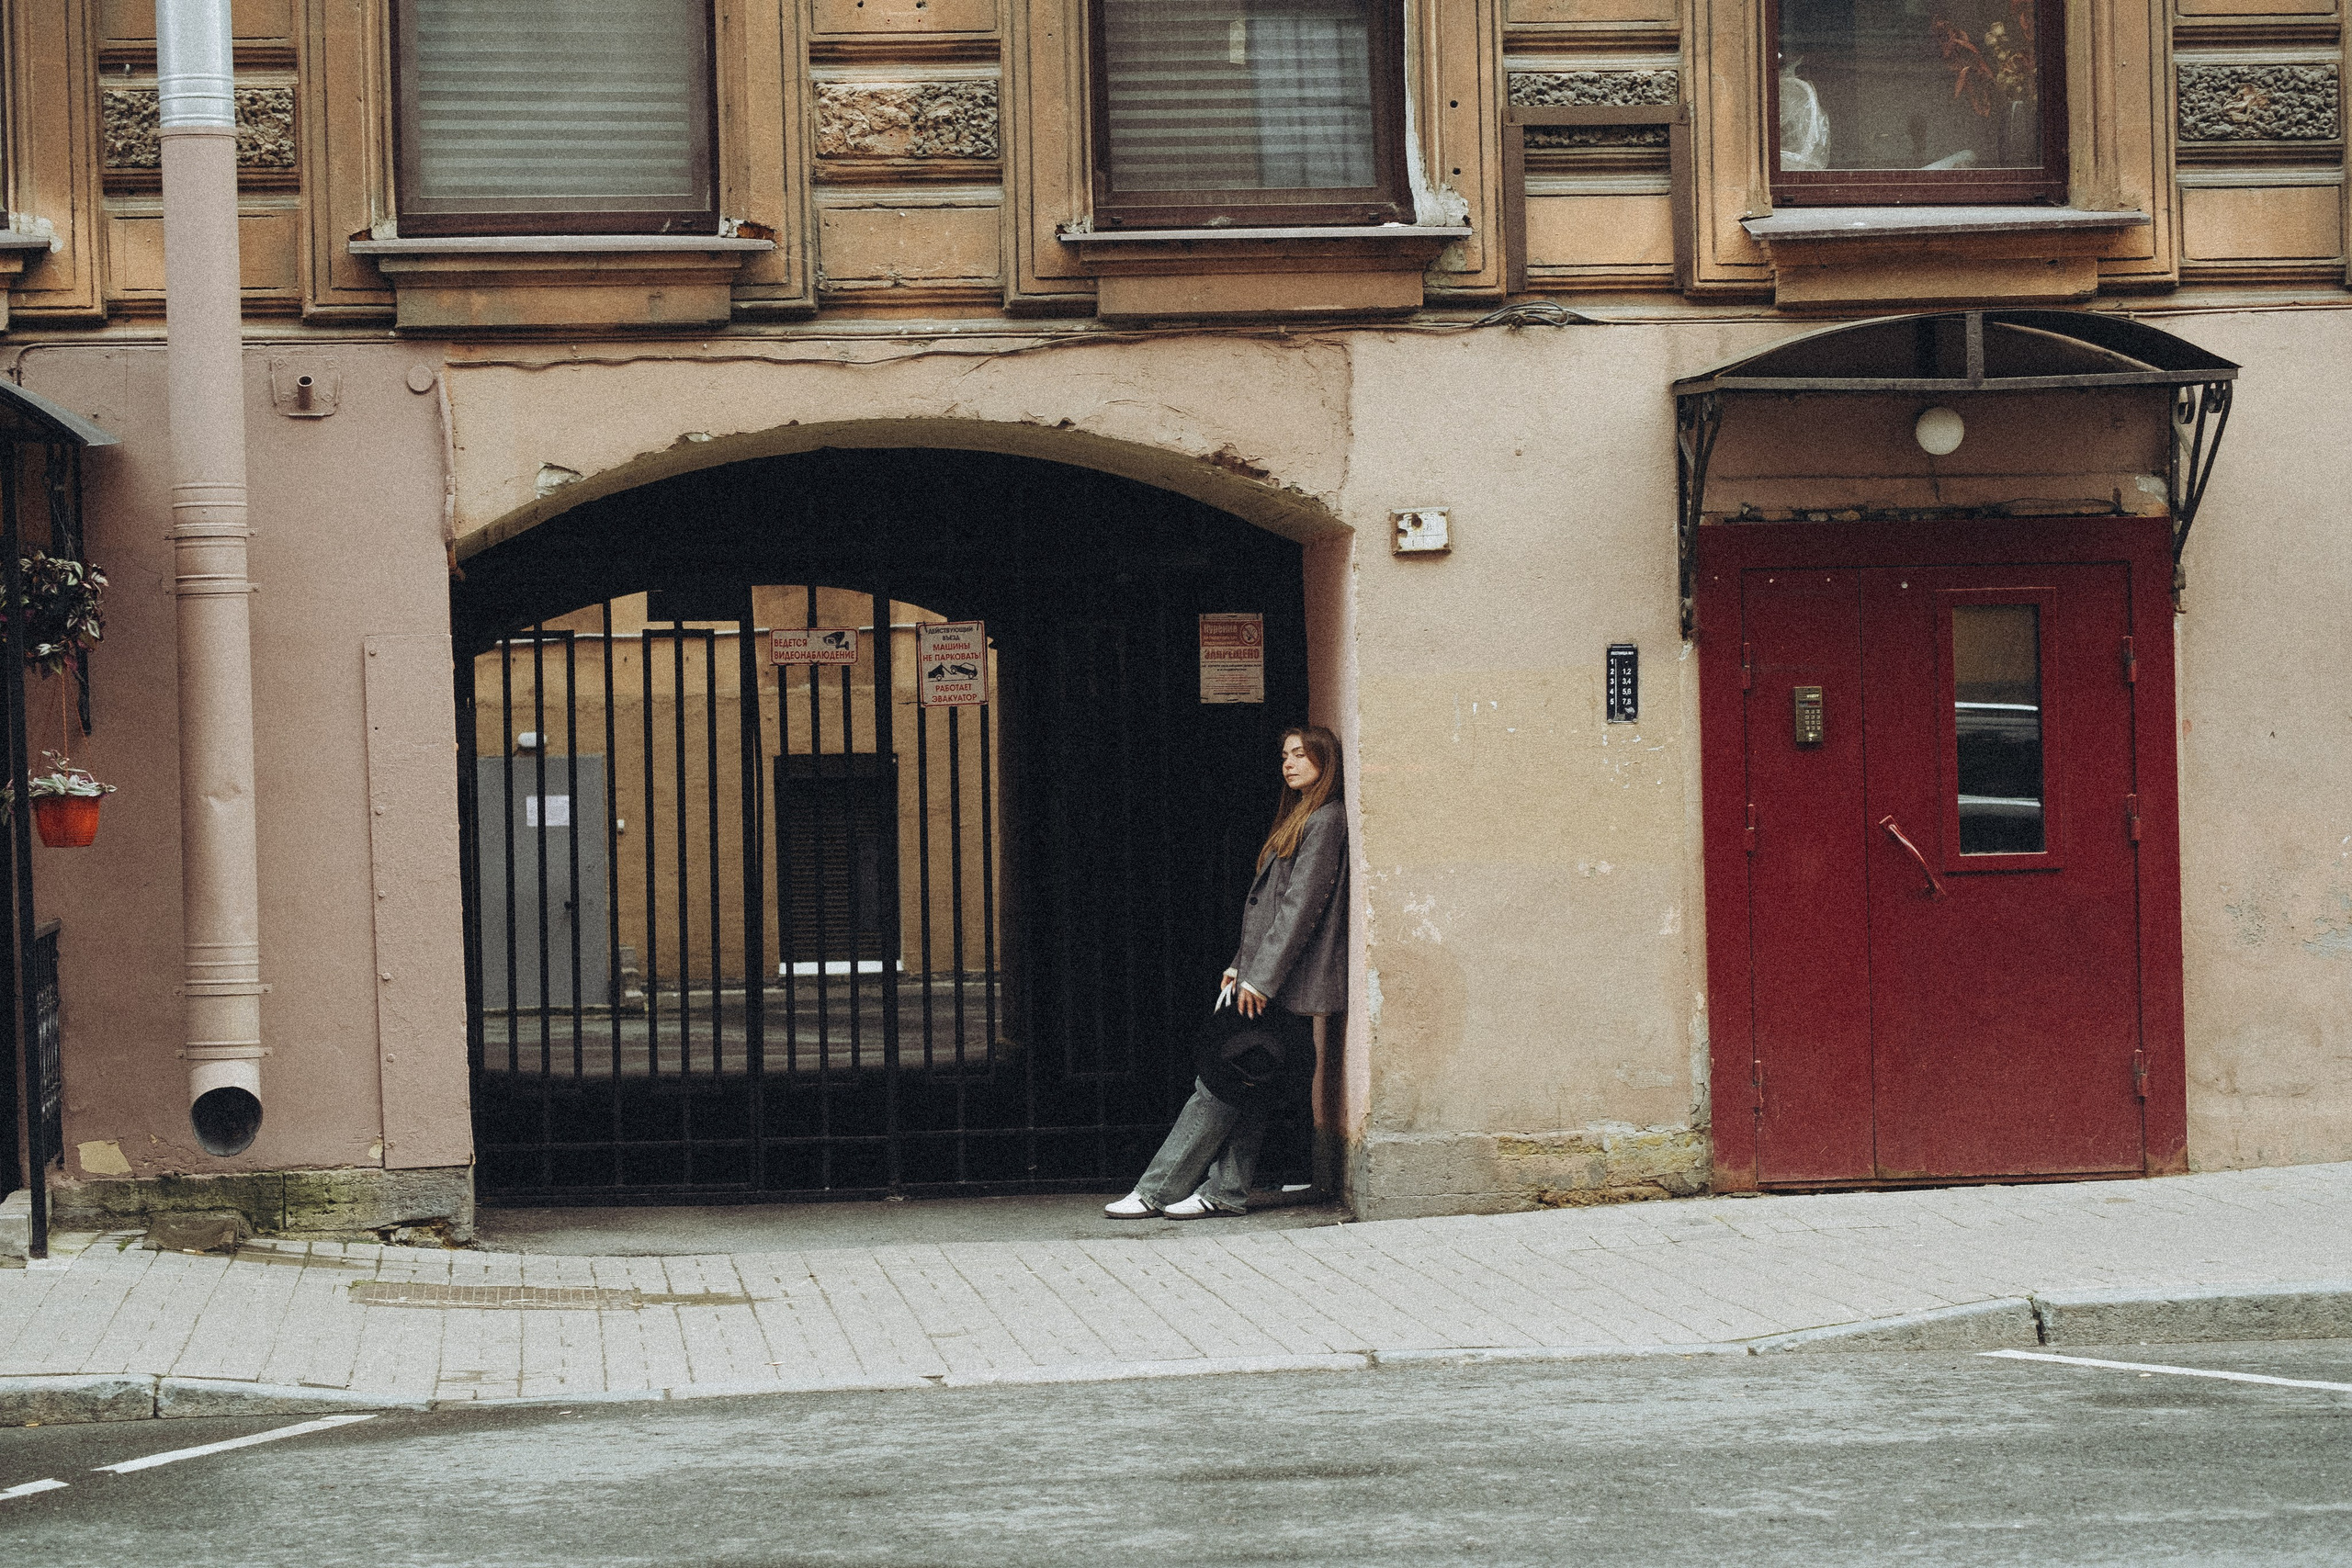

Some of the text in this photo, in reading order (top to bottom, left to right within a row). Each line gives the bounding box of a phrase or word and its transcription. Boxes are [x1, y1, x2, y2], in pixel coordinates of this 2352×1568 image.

[928, 626, 973, 635] ДЕЙСТВУЮЩИЙ
[774, 638, 808, 648] ВЕДЕТСЯ
[933, 643, 970, 651] МАШИНЫ
[774, 650, 855, 660] ВИДЕОНАБЛЮДЕНИЕ
[934, 652, 981, 661] ПАРКОВАТЬ!
[1204, 649, 1260, 660] ЗАПРЕЩЕНО
[1622, 677, 1632, 685] 3,4
[935, 683, 972, 692] РАБОТАЕТ
[932, 694, 978, 703] ЭВАКУАТОР
